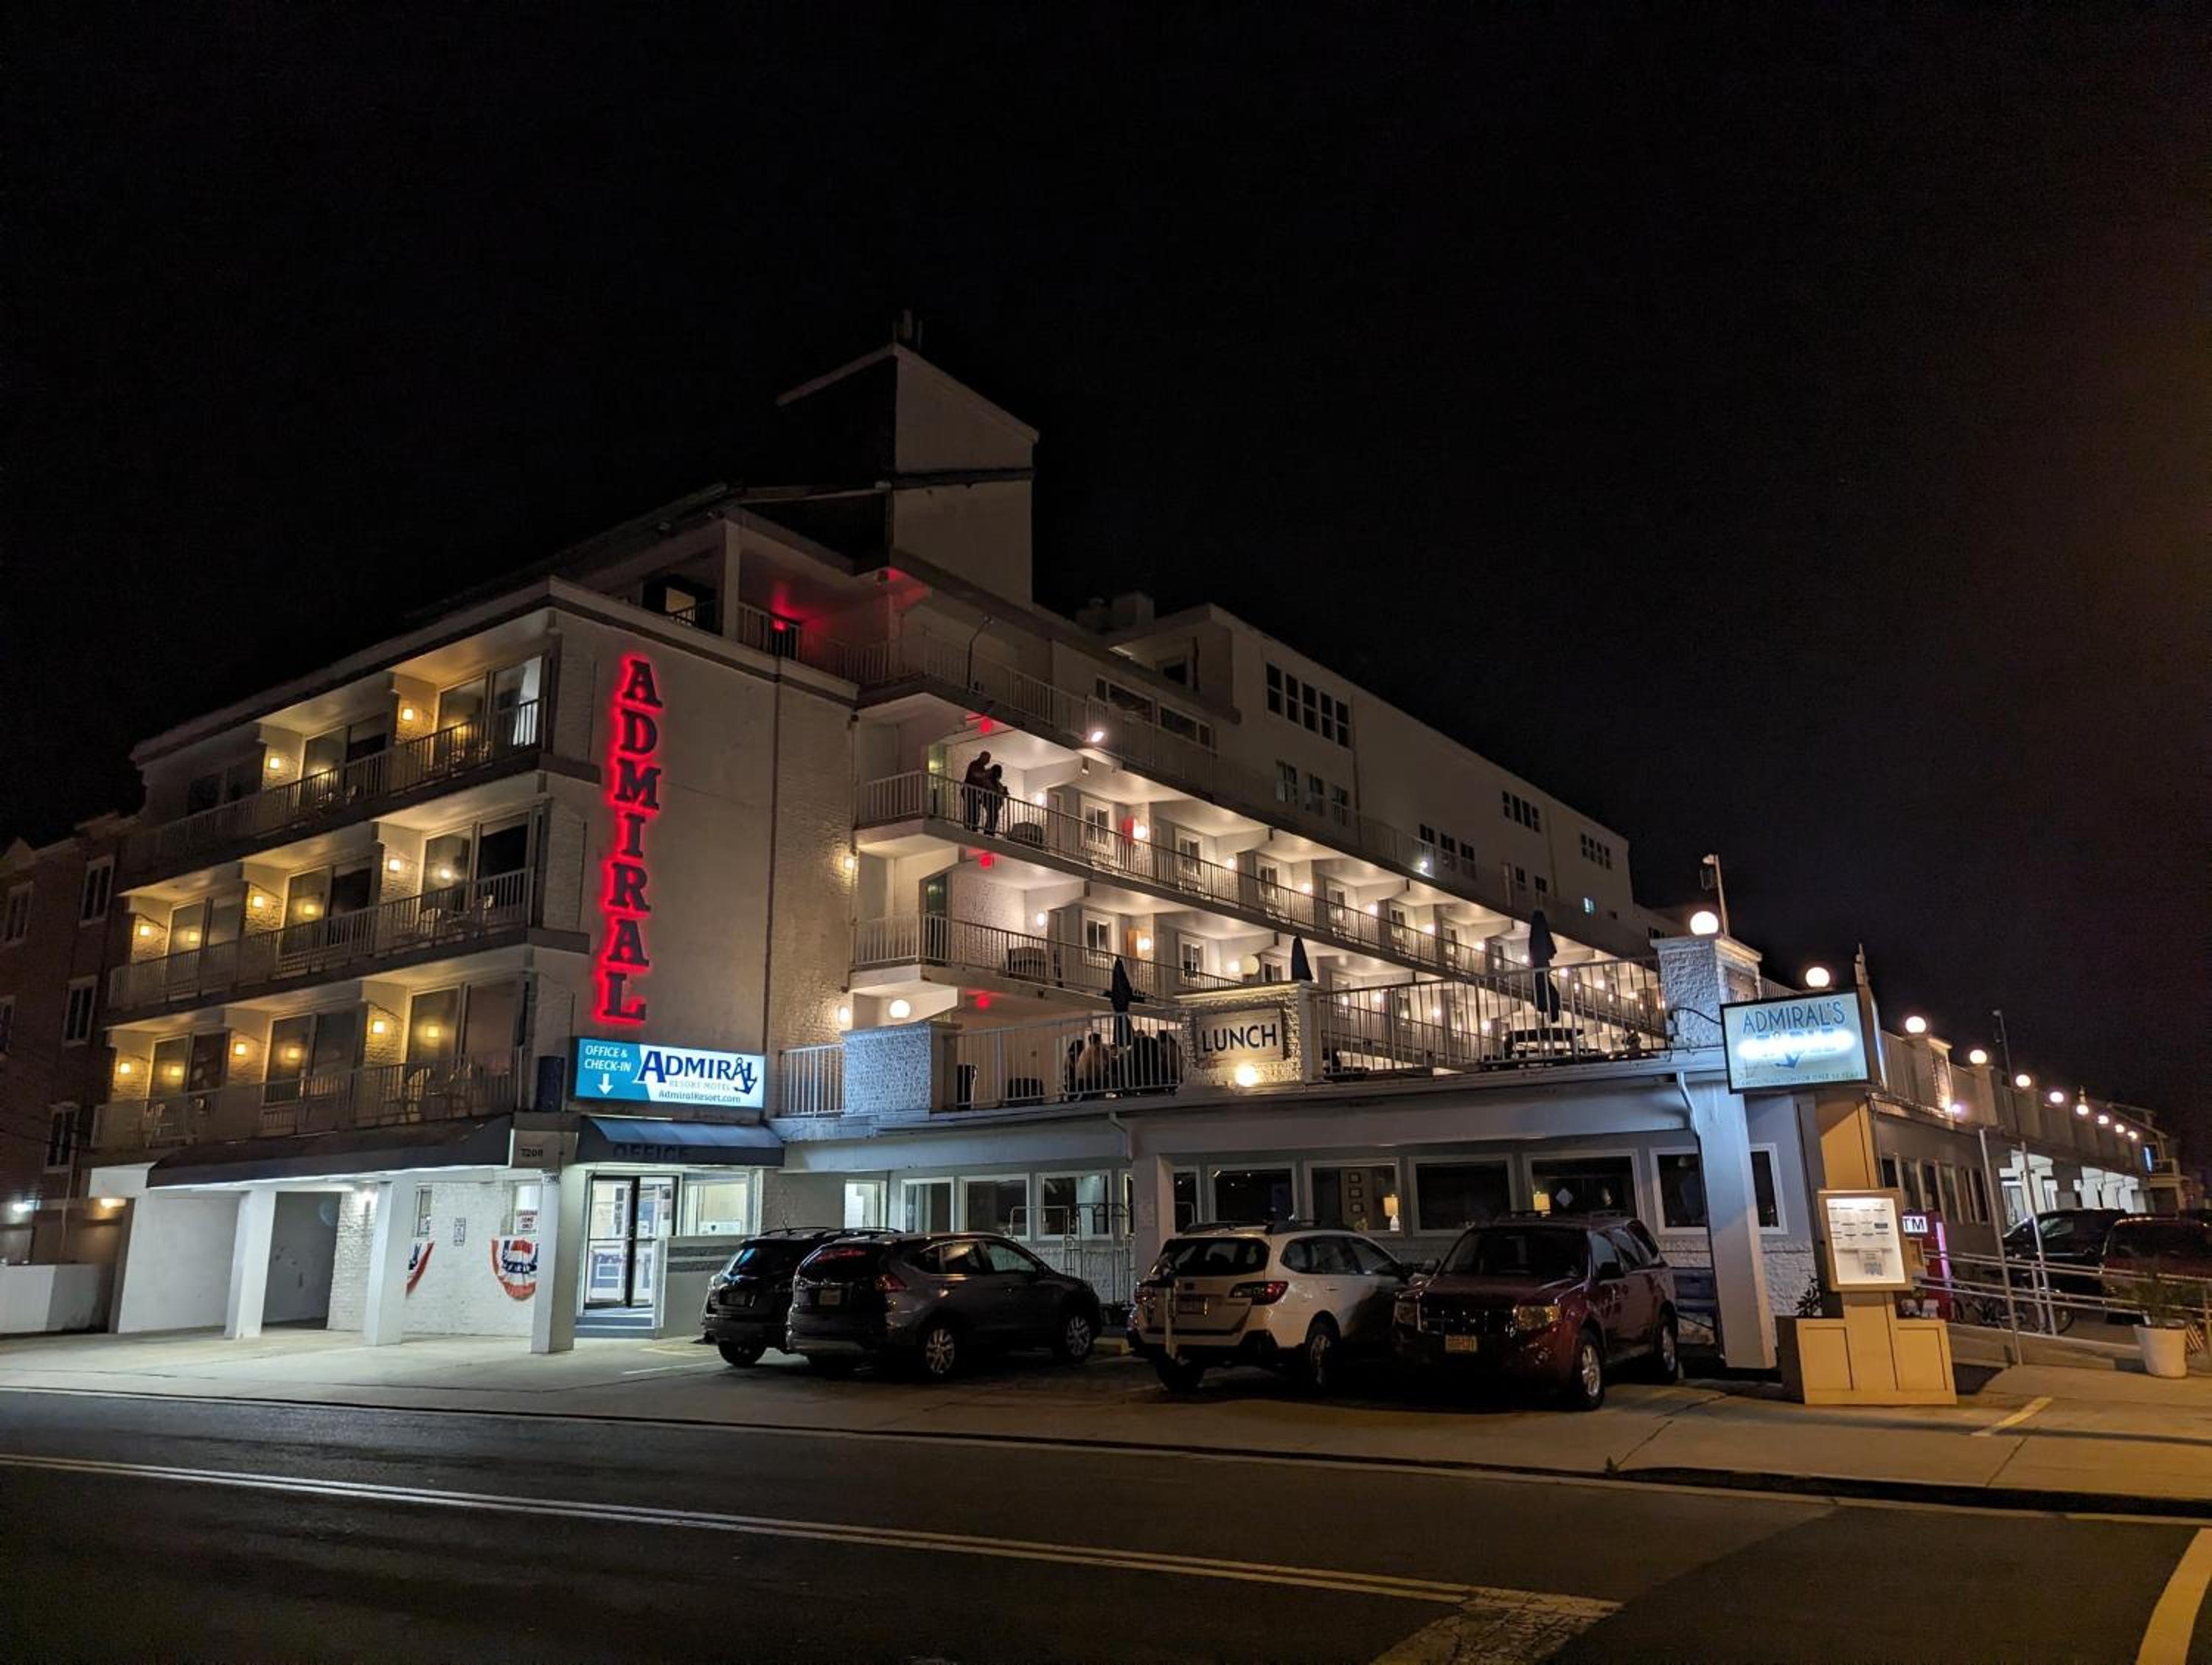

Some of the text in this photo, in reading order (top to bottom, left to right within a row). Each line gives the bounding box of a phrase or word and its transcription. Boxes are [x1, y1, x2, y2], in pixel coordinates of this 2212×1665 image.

[602, 660, 662, 1021] ADMIRAL
[1742, 1001, 1846, 1034] ADMIRAL'S
[1202, 1023, 1277, 1052] LUNCH
[585, 1045, 628, 1058] OFFICE &
[584, 1058, 632, 1073] CHECK-IN
[637, 1050, 757, 1094] ADMIRAL
[658, 1090, 741, 1104] AdmiralResort.com
[1904, 1218, 1924, 1231] TM
